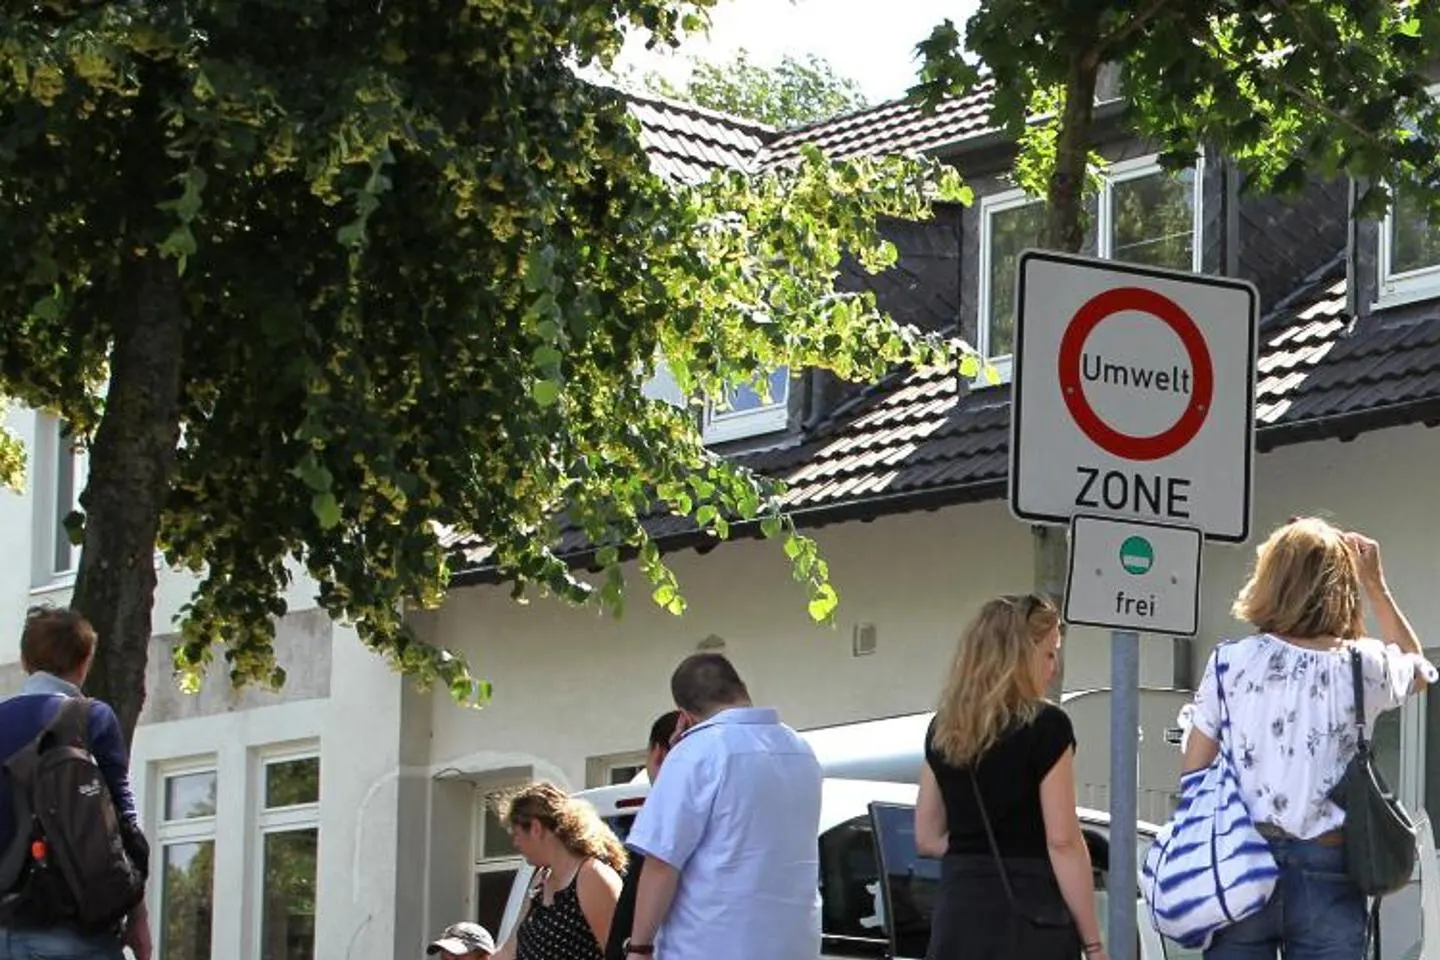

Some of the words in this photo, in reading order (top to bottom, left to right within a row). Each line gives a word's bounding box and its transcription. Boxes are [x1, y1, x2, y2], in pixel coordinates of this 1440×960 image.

[1082, 352, 1190, 394] Umwelt
[1074, 466, 1191, 518] ZONE
[1115, 591, 1156, 617] frei
